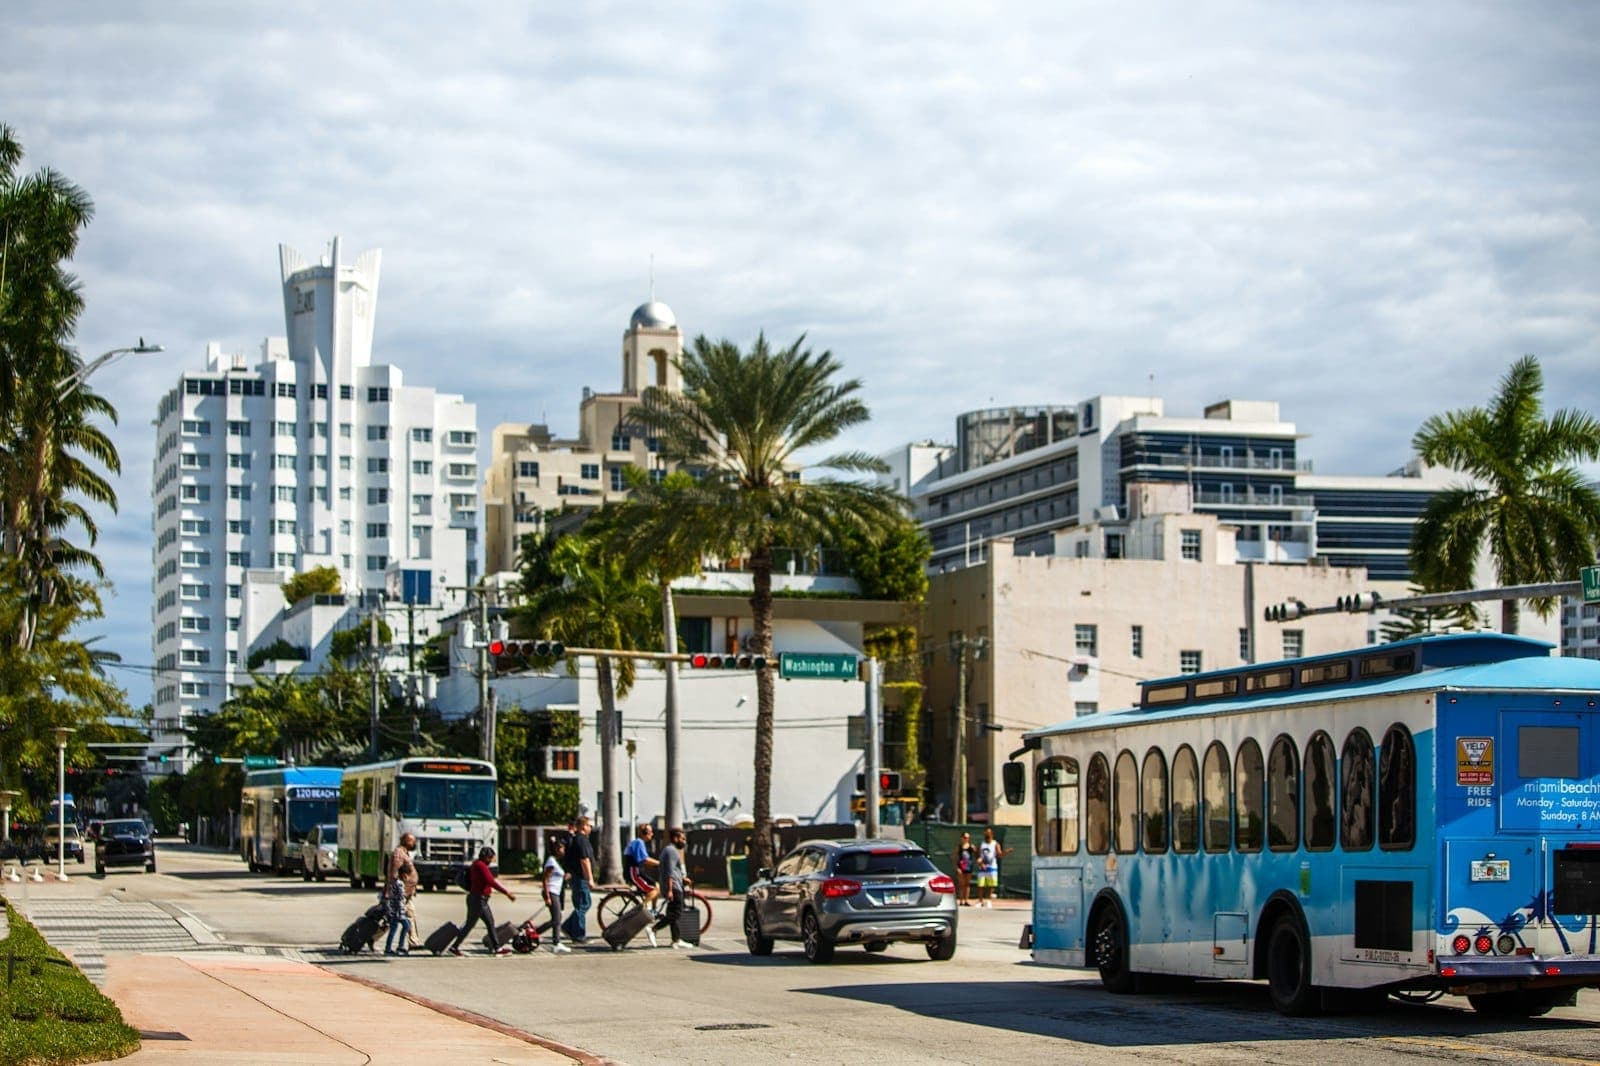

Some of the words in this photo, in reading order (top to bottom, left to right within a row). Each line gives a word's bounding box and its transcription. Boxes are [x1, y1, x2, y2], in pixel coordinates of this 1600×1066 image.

[785, 659, 835, 675] Washington
[841, 660, 854, 673] Av
[1466, 742, 1486, 750] YIELD
[296, 788, 311, 799] 120
[311, 788, 335, 799] BEACH
[1467, 786, 1492, 796] FREE
[1467, 797, 1492, 807] RIDE
[1516, 797, 1554, 810] Monday
[1541, 810, 1579, 823] Sundays:
[1581, 811, 1587, 821] 8
